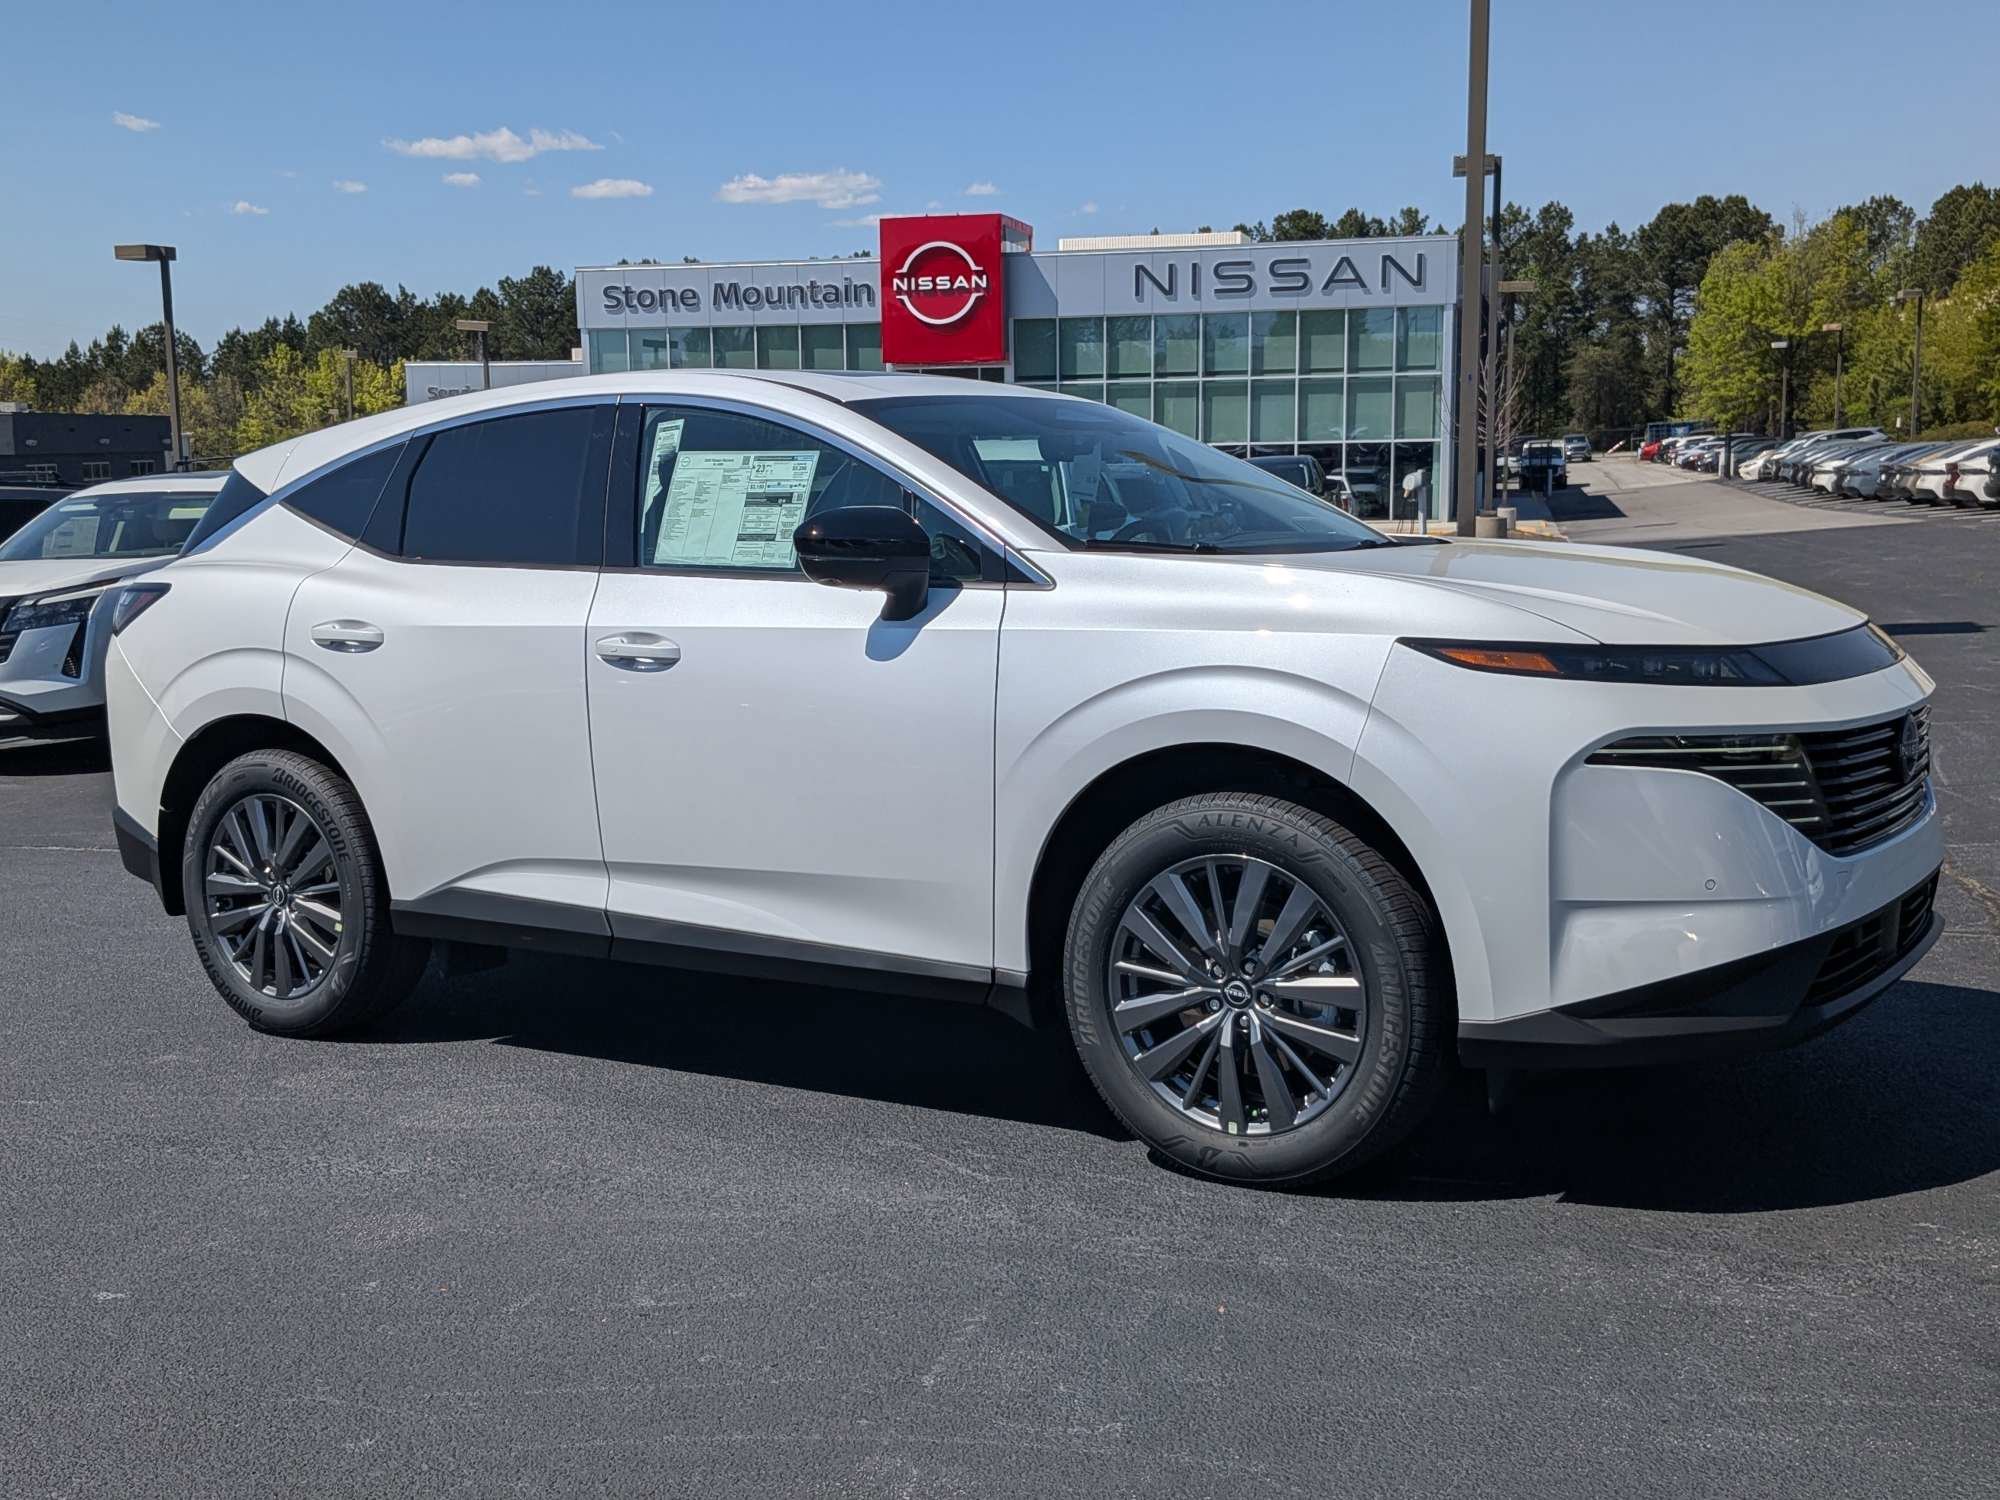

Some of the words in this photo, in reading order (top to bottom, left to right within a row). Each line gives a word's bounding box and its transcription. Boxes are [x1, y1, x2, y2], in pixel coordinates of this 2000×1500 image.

[602, 285, 701, 311] Stone
[712, 277, 875, 307] Mountain
[892, 274, 988, 292] NISSAN
[1134, 252, 1425, 298] NISSAN
[272, 767, 351, 863] BRIDGESTONE
[1198, 813, 1299, 849] ALENZA
[193, 929, 264, 1021] BRIDGESTONE
[1073, 876, 1115, 1046] BRIDGESTONE
[1352, 942, 1403, 1126] BRIDGESTONE
